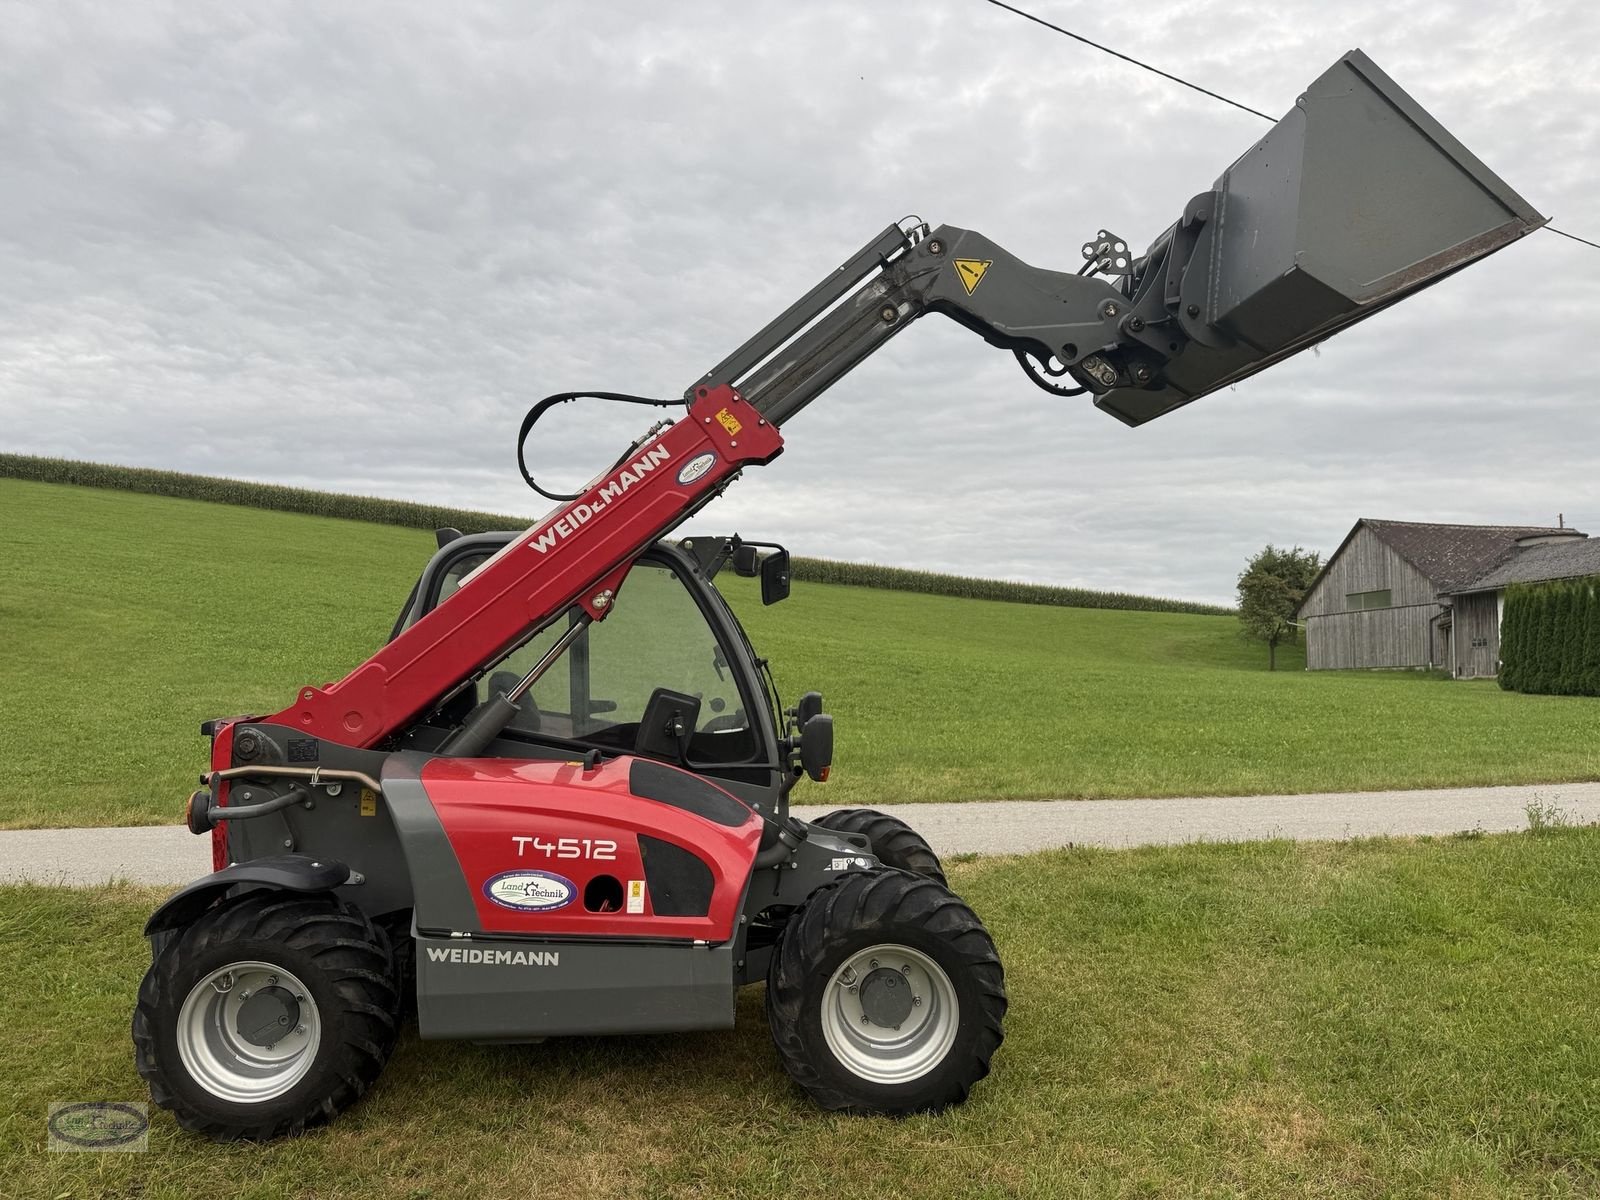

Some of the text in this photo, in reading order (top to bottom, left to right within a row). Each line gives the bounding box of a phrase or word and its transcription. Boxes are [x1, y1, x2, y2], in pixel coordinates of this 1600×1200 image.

[512, 836, 617, 860] T4512
[501, 881, 564, 898] Land Technik
[426, 947, 559, 966] WEIDEMANN
